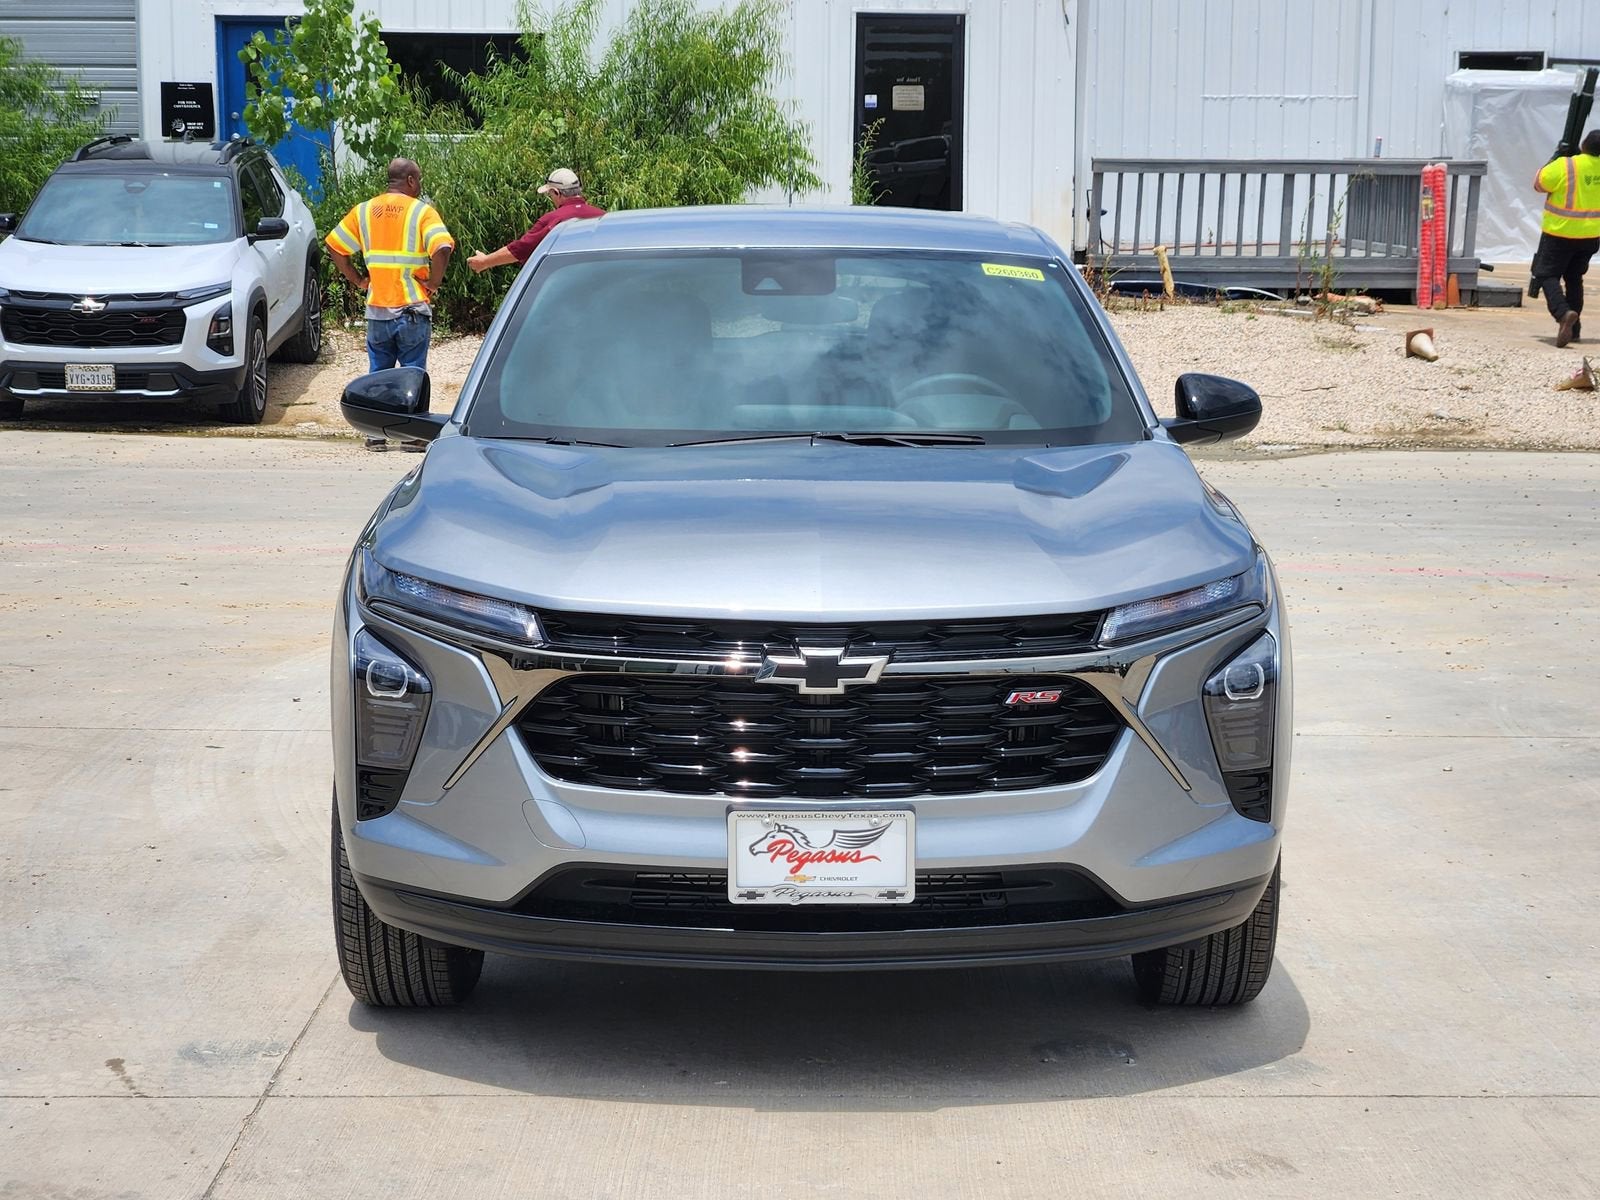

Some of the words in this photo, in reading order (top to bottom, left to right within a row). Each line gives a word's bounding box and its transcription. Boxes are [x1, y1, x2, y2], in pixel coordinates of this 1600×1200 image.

[385, 204, 404, 213] AWP
[986, 267, 1039, 279] C260360
[1005, 690, 1062, 704] RS
[736, 812, 906, 820] www.PegasusChevyTexas.com
[766, 838, 882, 875] Pegasus
[772, 886, 872, 902] Pegasus
